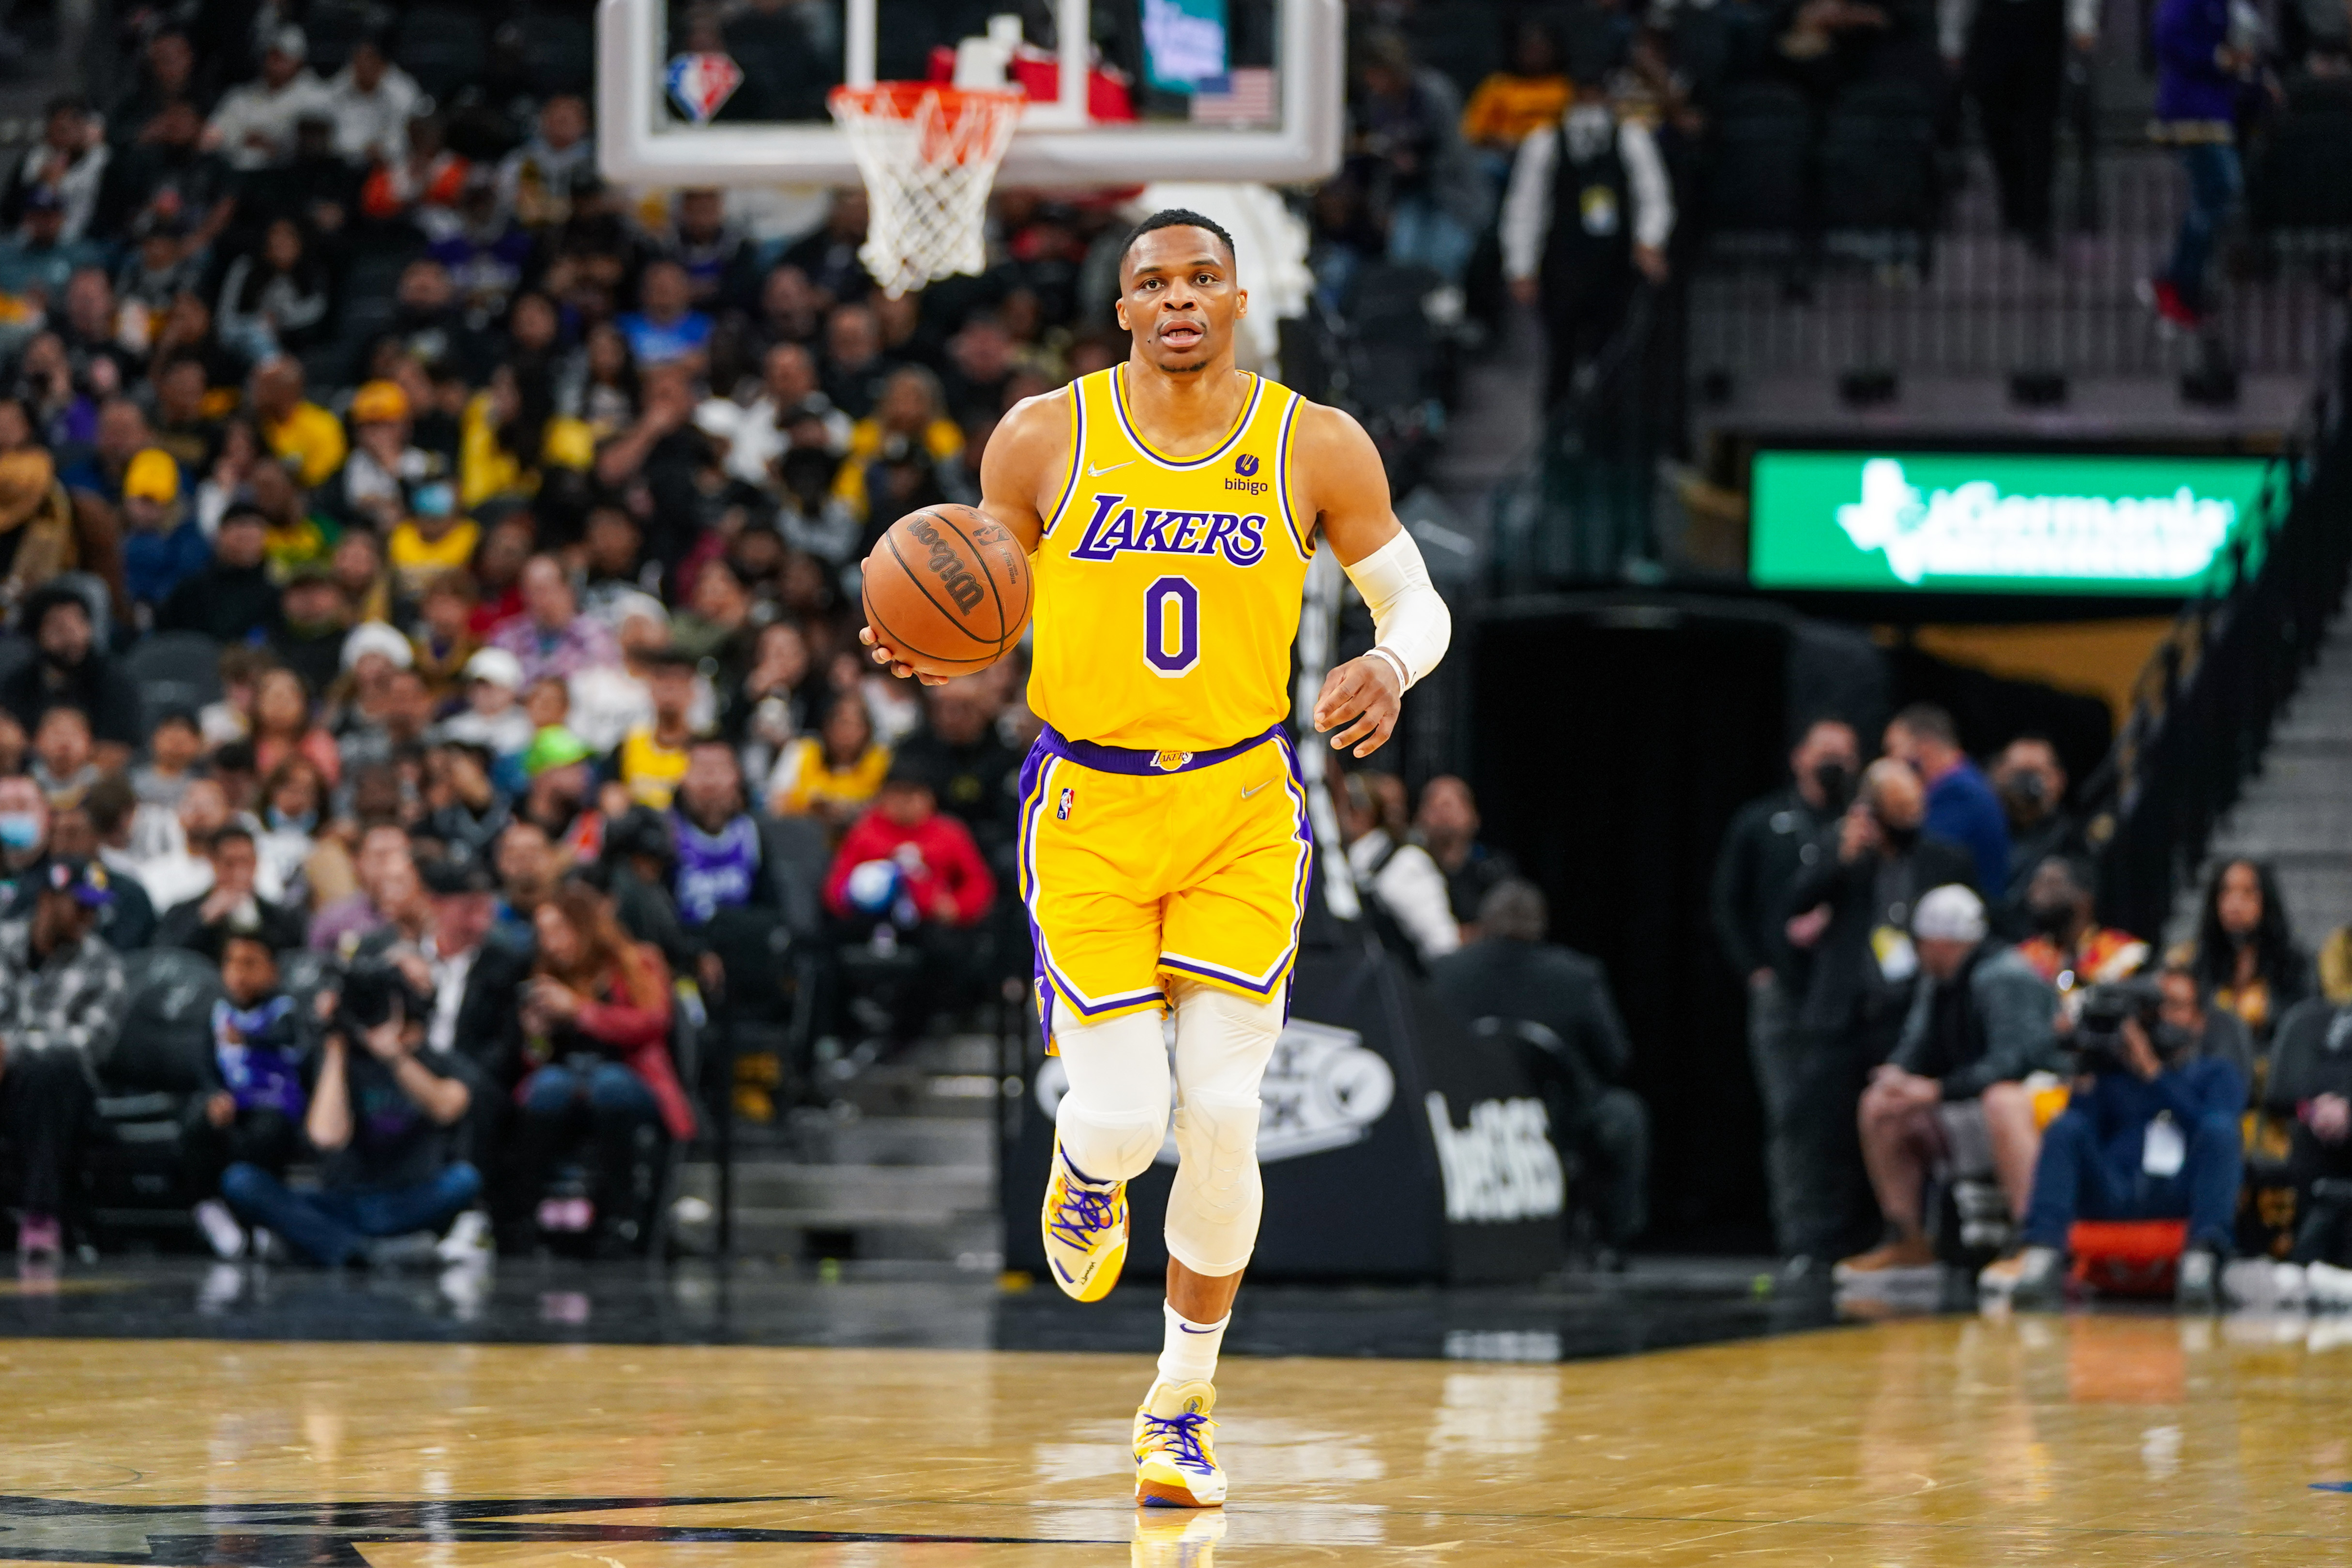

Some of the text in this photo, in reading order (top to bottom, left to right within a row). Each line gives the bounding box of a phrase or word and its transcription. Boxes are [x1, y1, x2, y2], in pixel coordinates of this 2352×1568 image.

[1225, 478, 1268, 495] bibigo
[907, 517, 985, 616] Wilson
[1068, 493, 1268, 568] LAKERS
[1143, 575, 1200, 679] 0
[1150, 750, 1193, 766] LAKERS
